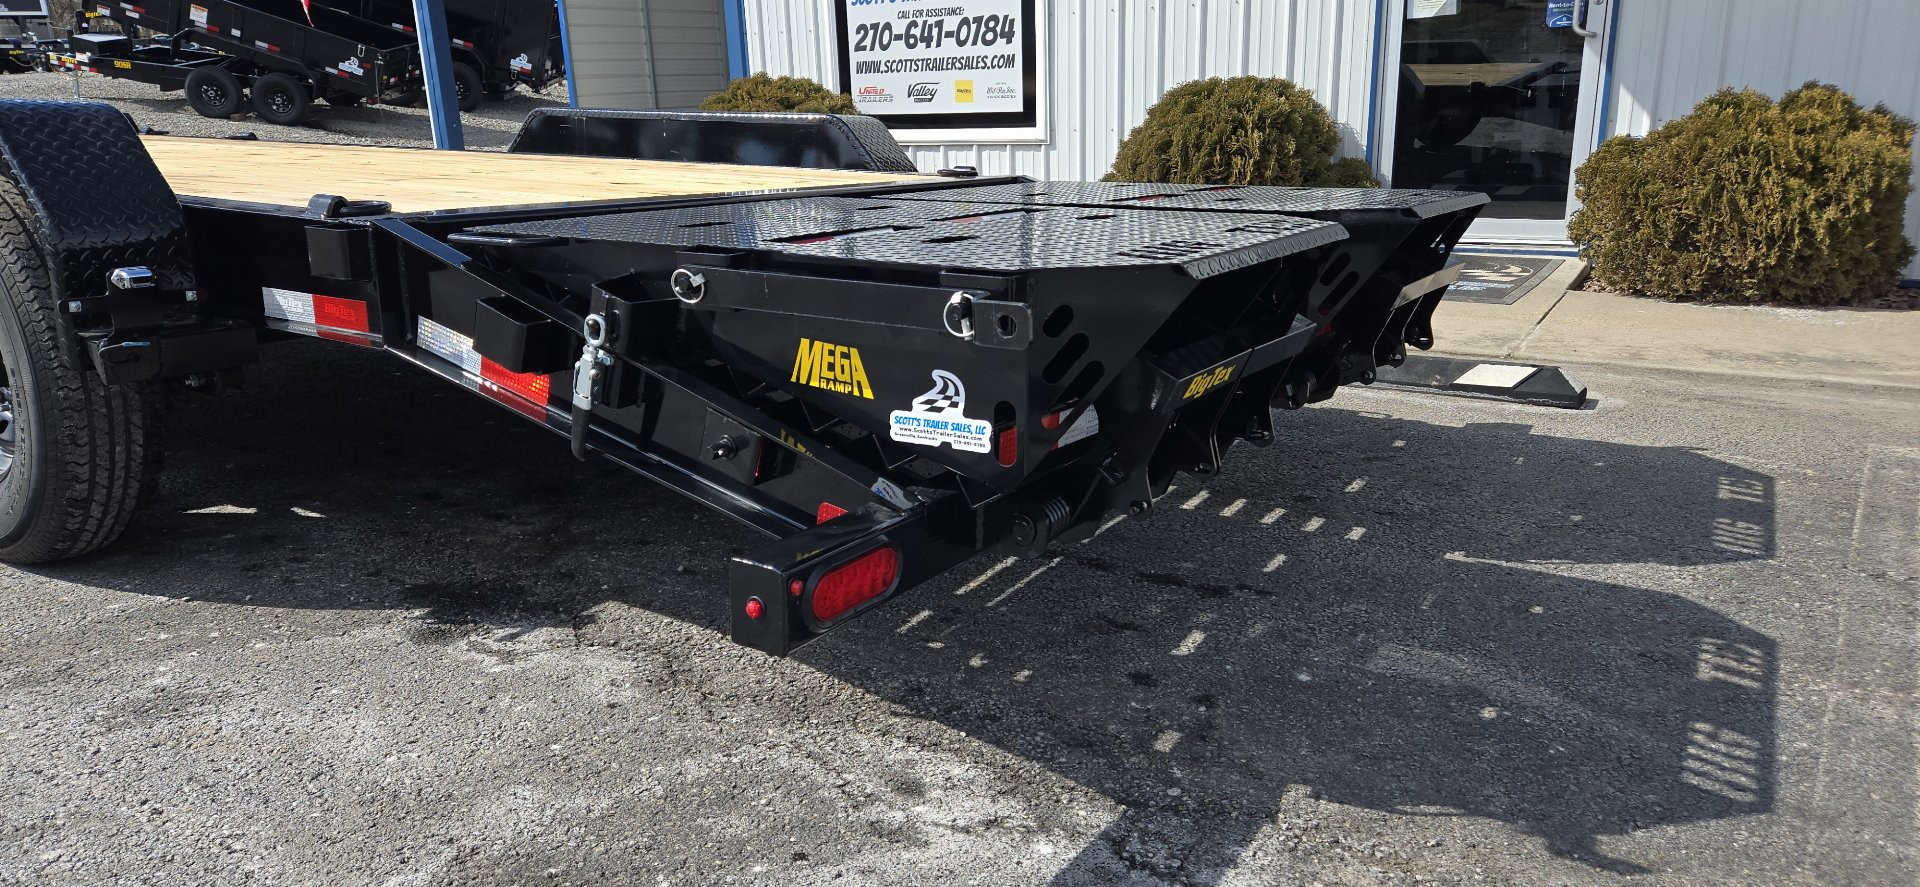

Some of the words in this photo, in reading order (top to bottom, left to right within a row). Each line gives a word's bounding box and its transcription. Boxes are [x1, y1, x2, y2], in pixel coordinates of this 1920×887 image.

[897, 10, 910, 19] CALL
[912, 9, 924, 18] FOR
[854, 14, 1016, 52] 270-641-0784
[856, 53, 1016, 75] WWW.SCOTTSTRAILERSALES.COM
[907, 82, 940, 102] Valley
[790, 337, 875, 400] MEGA
[820, 378, 853, 394] RAMP
[1183, 364, 1237, 399] BigTex
[894, 415, 921, 427] SCOTT'S
[923, 419, 949, 430] TRAILER
[951, 422, 974, 435] SALES,
[975, 425, 987, 435] LLC
